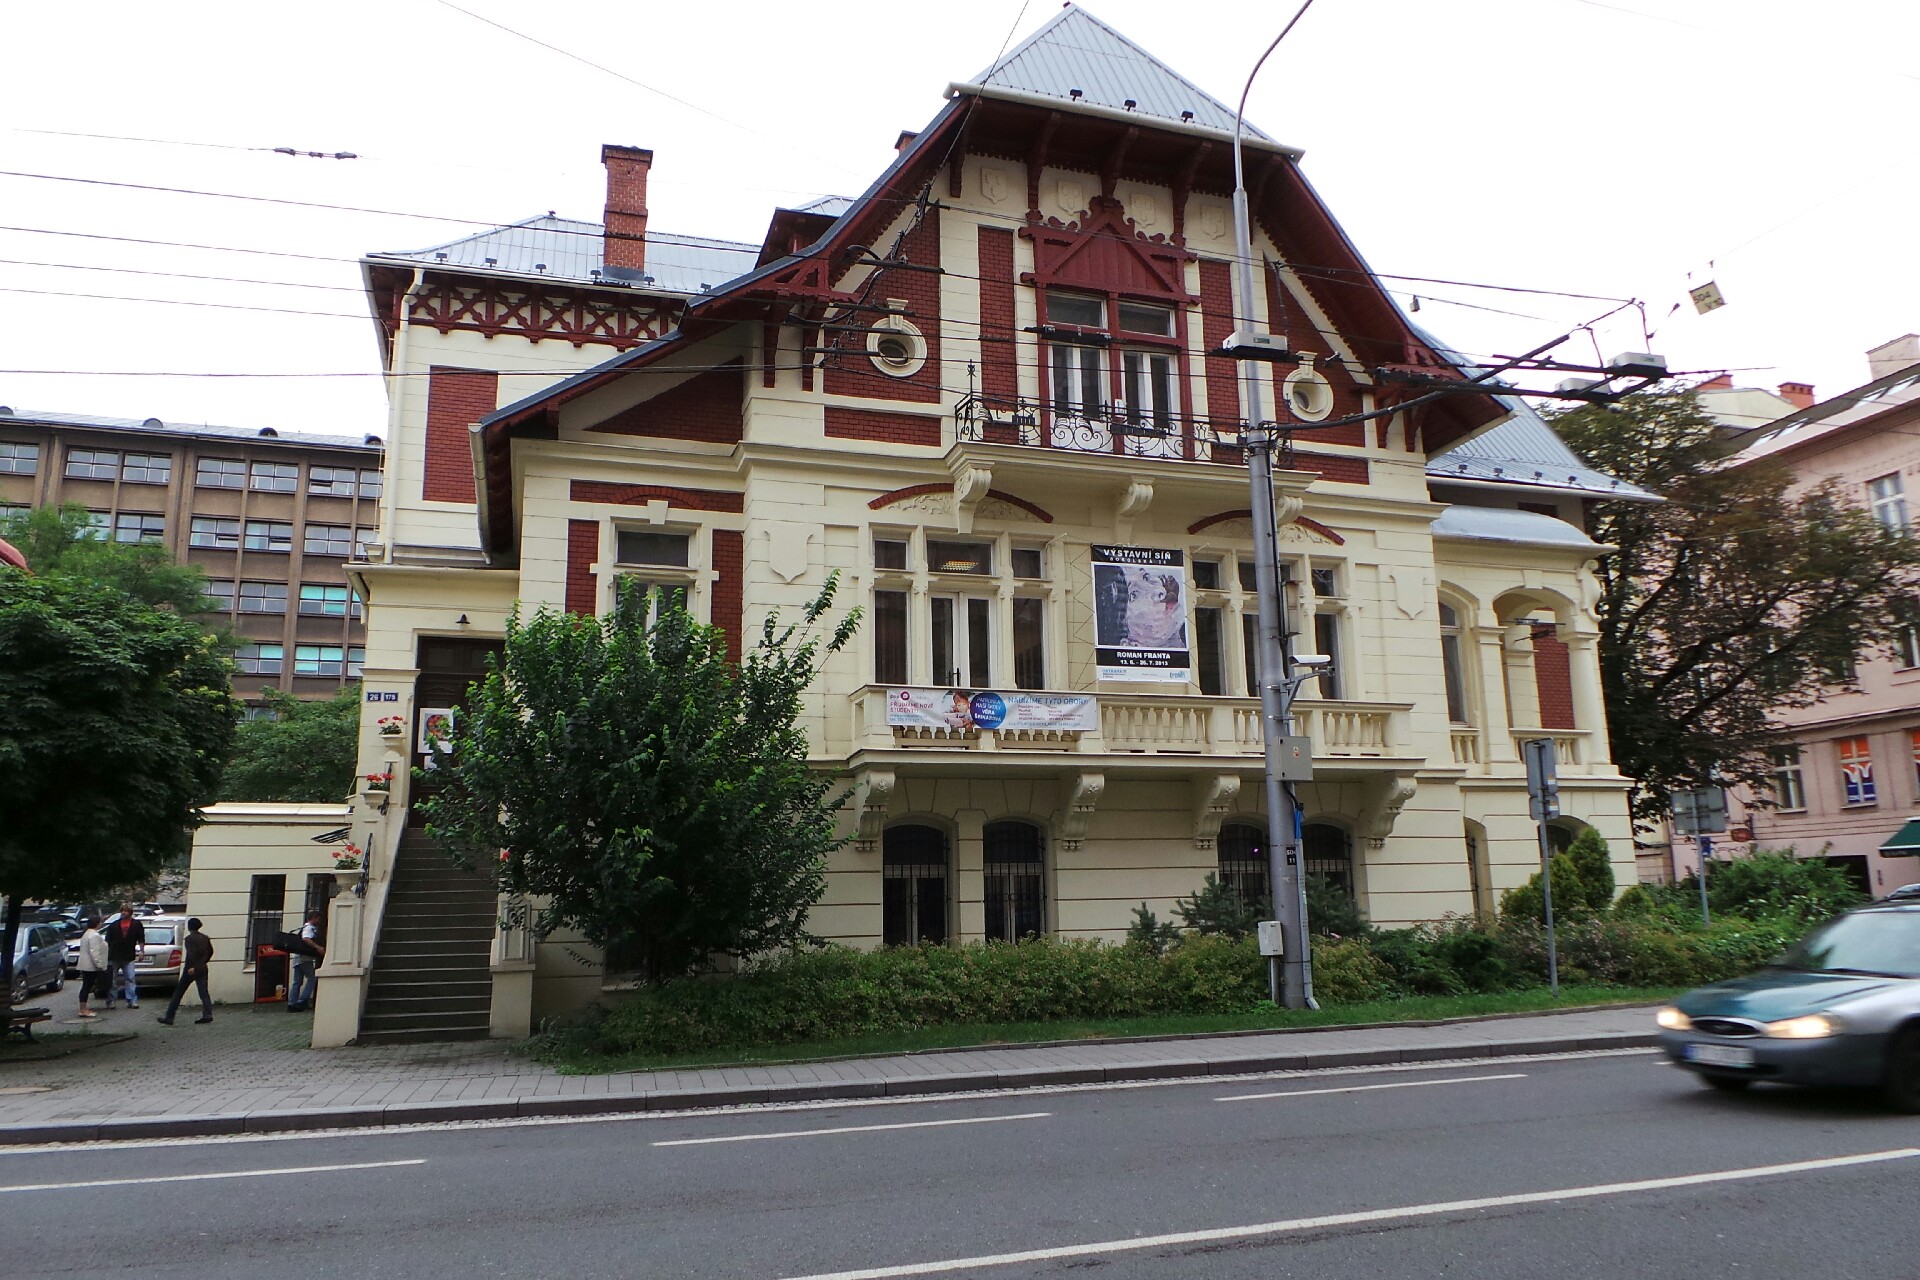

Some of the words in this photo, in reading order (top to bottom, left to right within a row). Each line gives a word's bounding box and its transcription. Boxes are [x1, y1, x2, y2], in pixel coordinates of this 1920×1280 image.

[1103, 548, 1152, 559] VÝSTAVNÍ
[1154, 551, 1171, 560] SÍŇ
[1116, 651, 1143, 659] ROMAN
[977, 697, 1001, 705] PATRONKA
[1008, 696, 1043, 704] NABÍZÍME
[1045, 697, 1062, 705] TYTO
